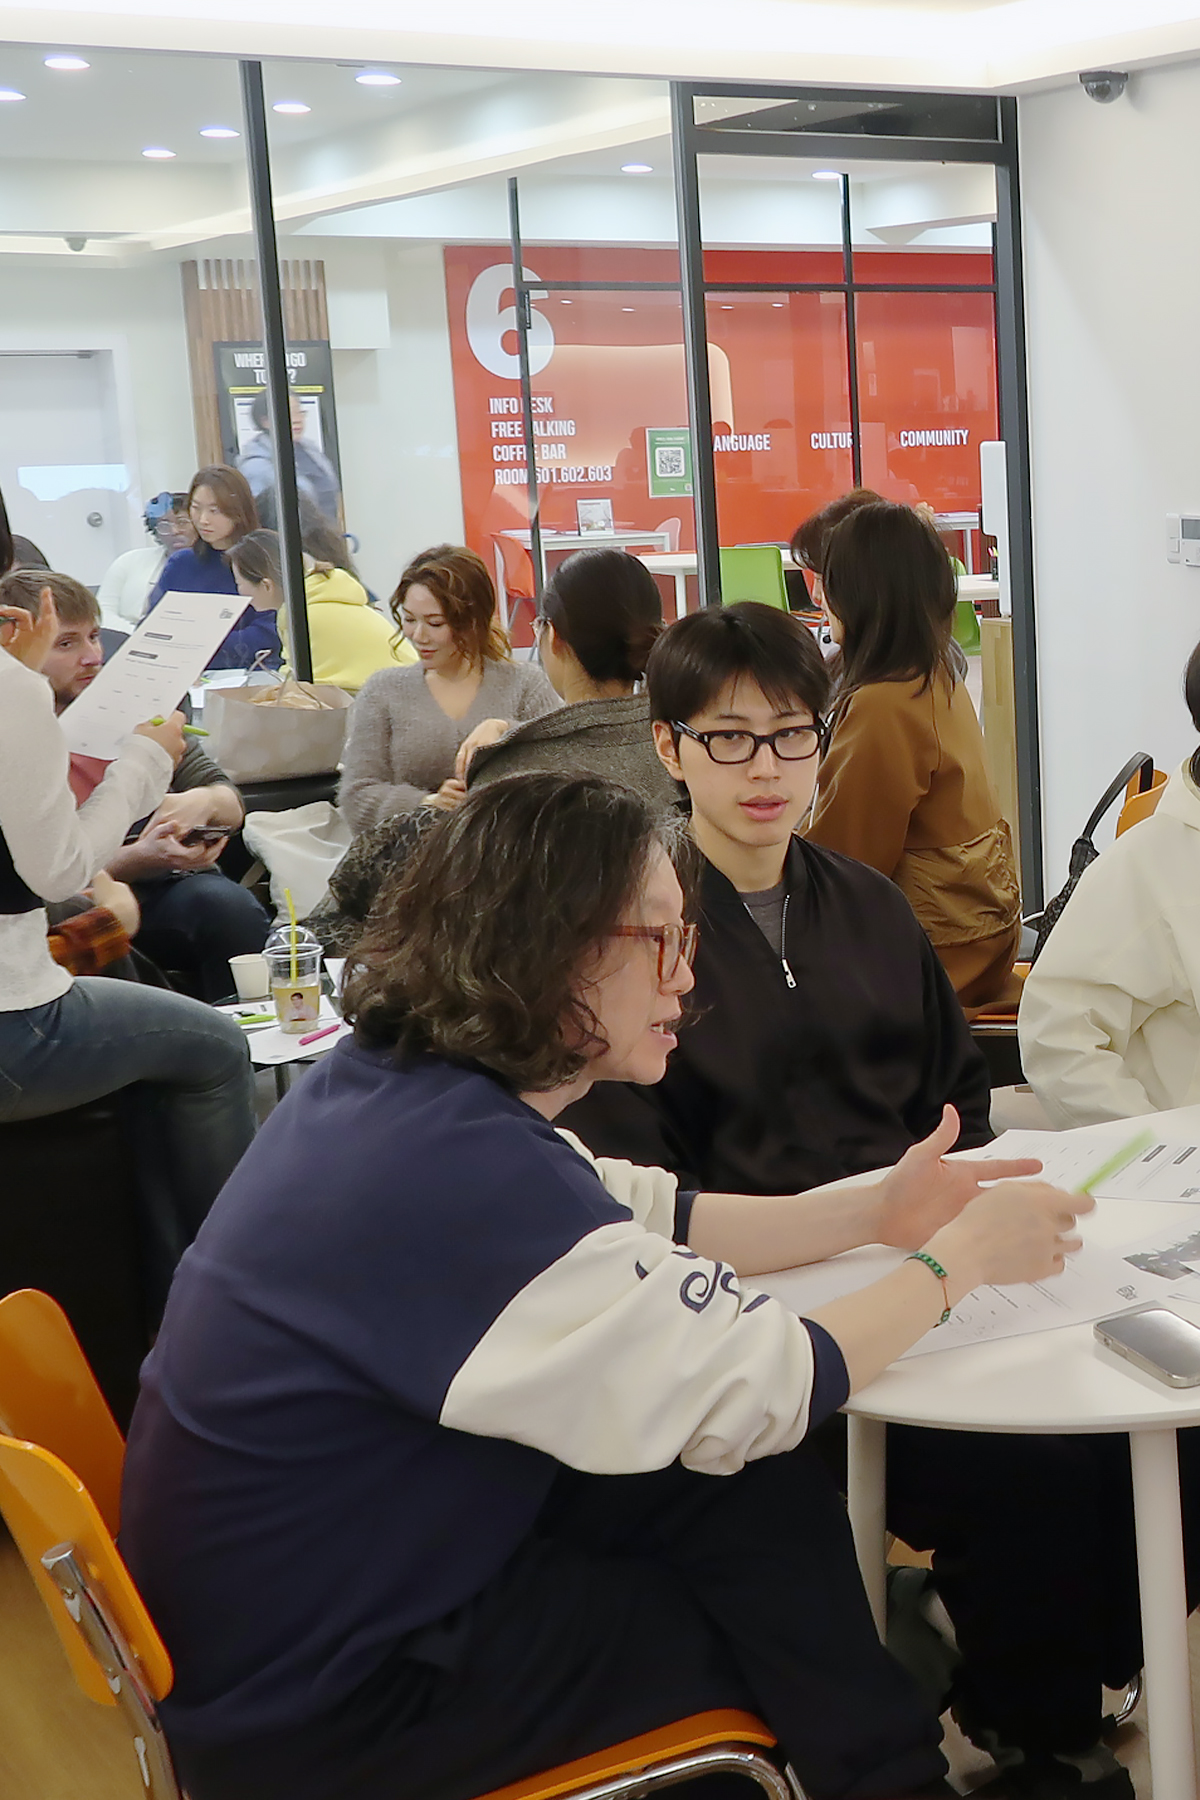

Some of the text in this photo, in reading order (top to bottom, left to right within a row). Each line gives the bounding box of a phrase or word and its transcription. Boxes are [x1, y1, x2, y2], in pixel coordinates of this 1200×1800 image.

[466, 263, 555, 379] 6
[489, 396, 554, 414] INFO ESK
[491, 419, 576, 438] FREE ALKING
[713, 429, 969, 452] ANGUAGE CULTUR COMMUNITY
[542, 443, 567, 460] BAR
